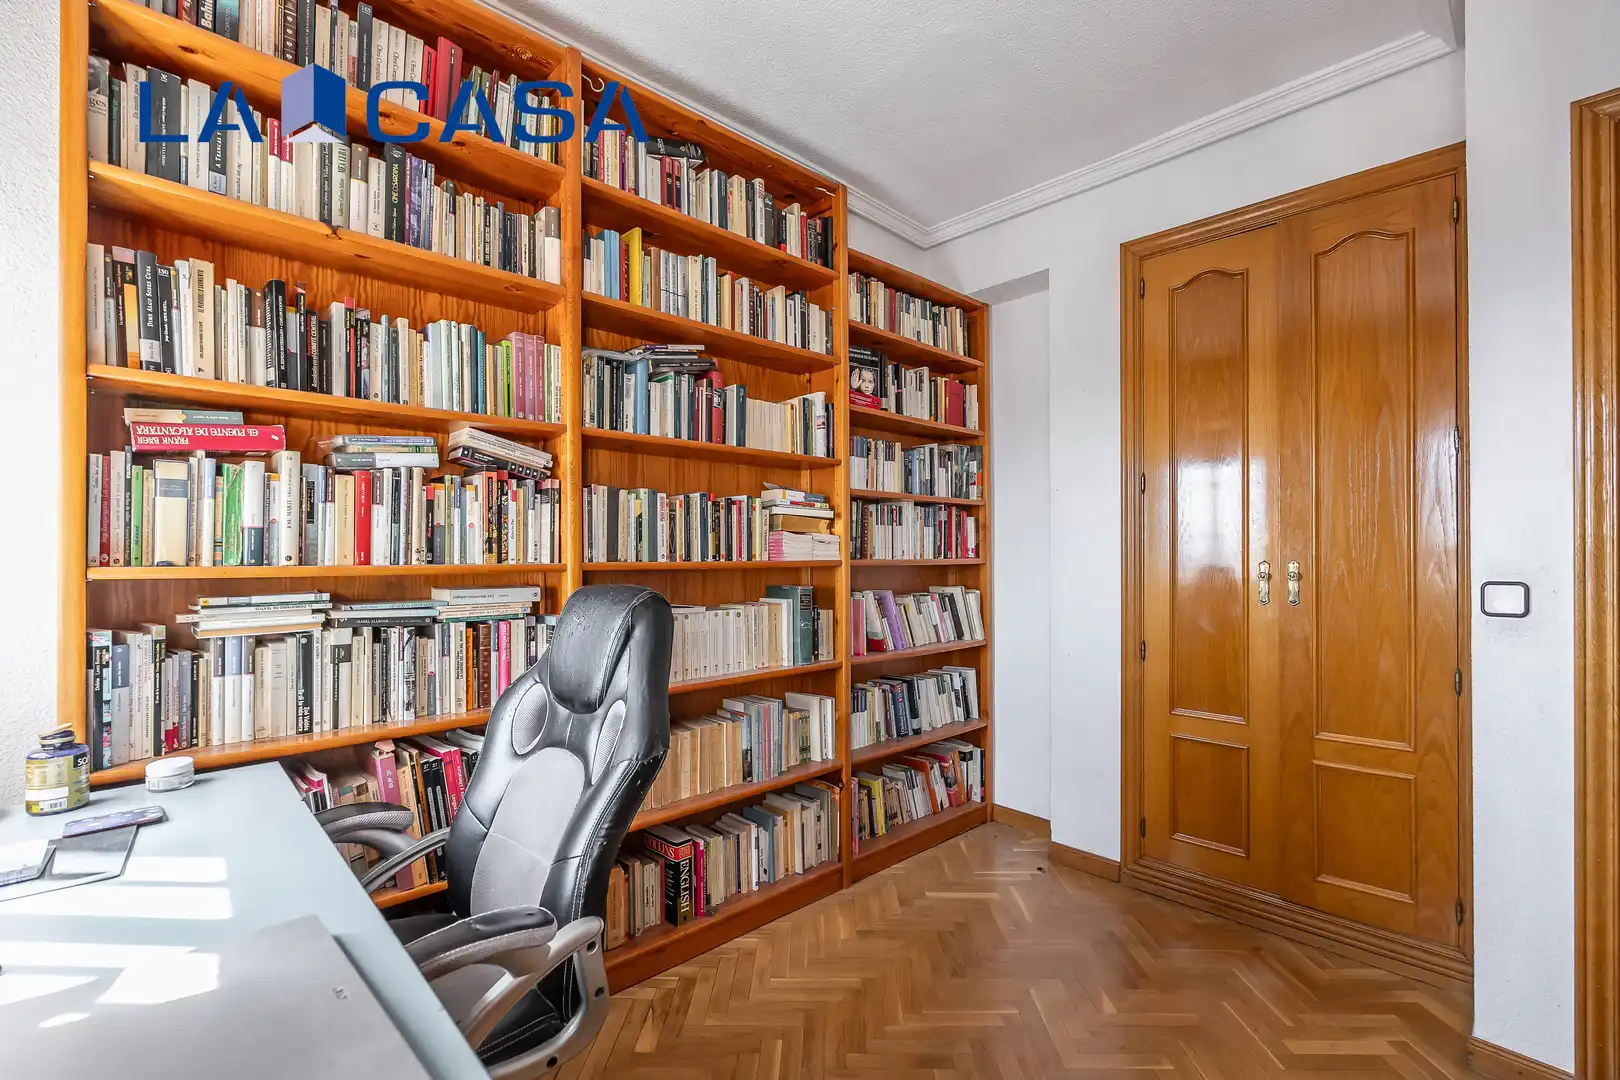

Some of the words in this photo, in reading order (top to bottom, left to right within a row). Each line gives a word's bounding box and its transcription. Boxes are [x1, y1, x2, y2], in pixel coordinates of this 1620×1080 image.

[194, 427, 208, 436] DE
[209, 428, 245, 436] PUENTE
[247, 428, 259, 437] EL
[136, 436, 159, 445] BAER
[162, 436, 189, 445] FRANK
[679, 859, 690, 912] ENGLISH
